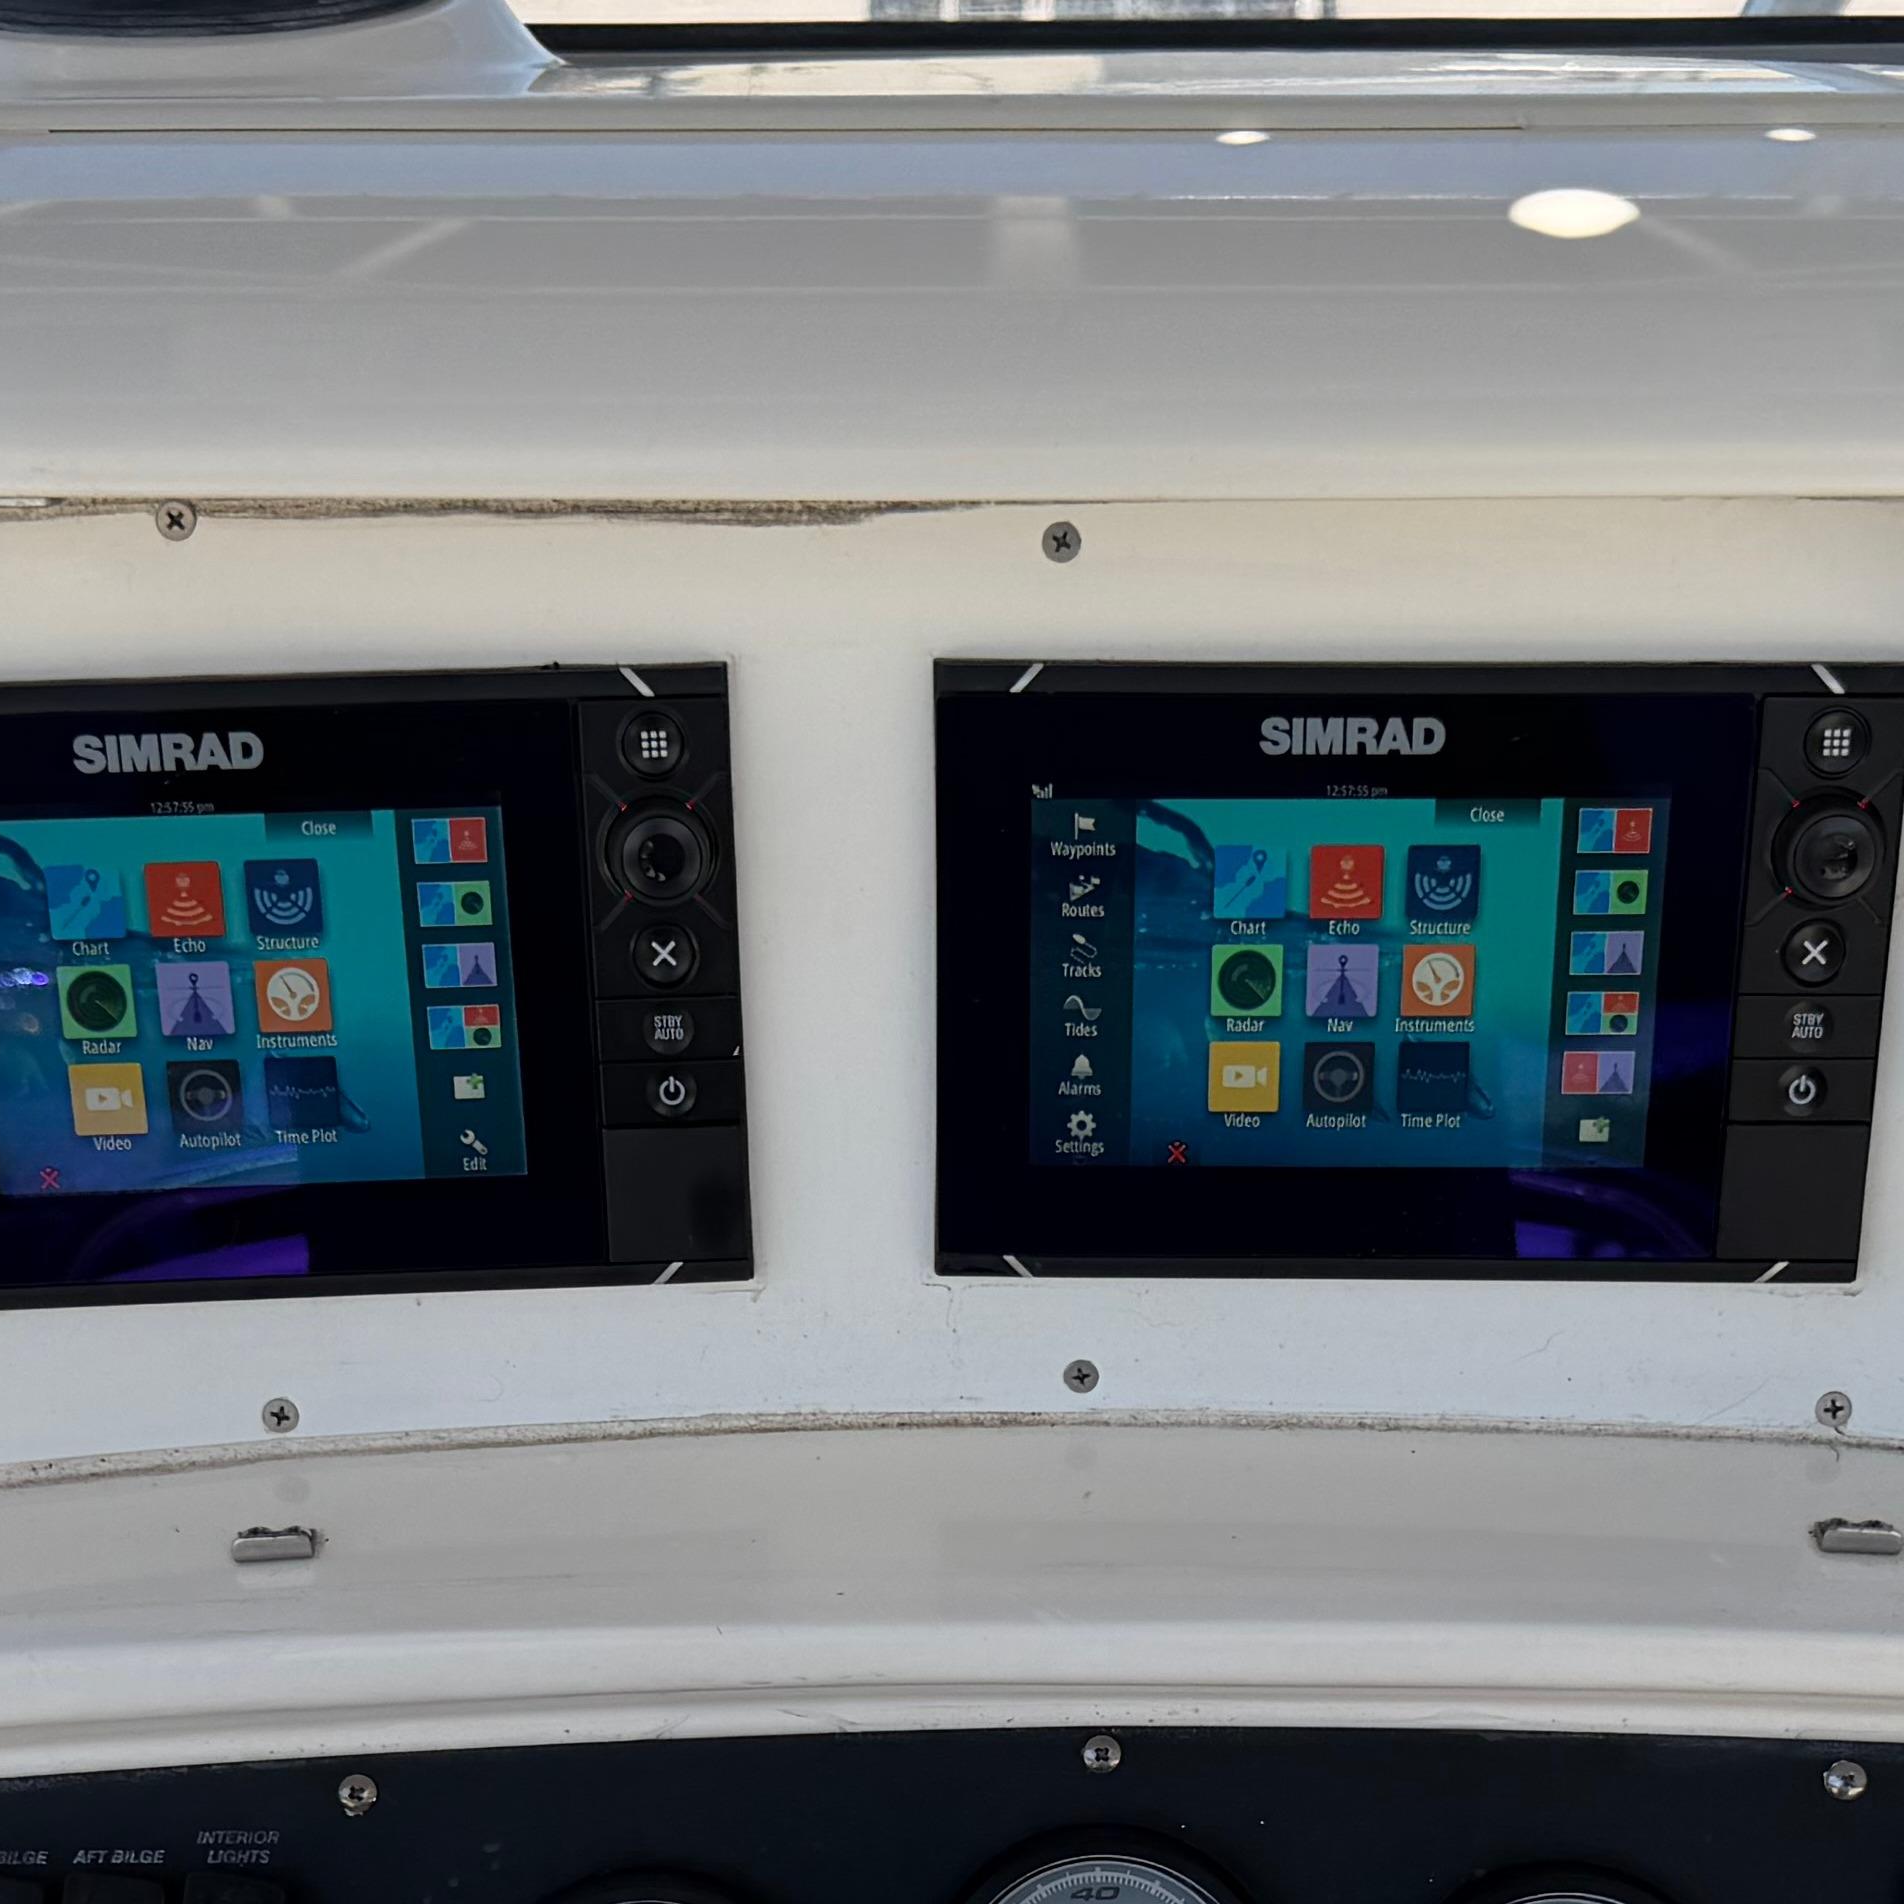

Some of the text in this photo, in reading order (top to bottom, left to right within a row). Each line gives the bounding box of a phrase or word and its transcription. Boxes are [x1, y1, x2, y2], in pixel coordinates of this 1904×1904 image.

[1259, 716, 1447, 756] SIMRAD
[73, 731, 265, 775] SIMRAD
[1326, 785, 1389, 798] 12:57:55 pm
[150, 802, 215, 814] 12:57:55 pm
[1470, 807, 1505, 823] Close
[302, 820, 337, 836] Close
[1050, 841, 1116, 859] Waypoints
[1062, 903, 1105, 918] Routes
[1230, 920, 1266, 936] Chart
[1328, 920, 1360, 936] Echo
[1410, 920, 1471, 936] Structure
[72, 940, 109, 957] Chart
[174, 937, 206, 953] Echo
[257, 934, 319, 951] Structure
[1062, 963, 1102, 979] Tracks
[654, 1014, 683, 1028] STBY
[1226, 1018, 1265, 1033] Radar
[1327, 1018, 1353, 1033] Nav
[1395, 1017, 1475, 1033] Instruments
[1793, 1012, 1824, 1026] STBY
[654, 1028, 684, 1040] AUTO
[1064, 1022, 1098, 1037] Tides
[1792, 1026, 1824, 1039] AUTO
[82, 1040, 122, 1056] Radar
[187, 1036, 213, 1051] Nav
[256, 1033, 338, 1049] Instruments
[1058, 1081, 1102, 1097] Alarms
[1224, 1113, 1261, 1128] Video
[1306, 1112, 1367, 1130] Autopilot
[1401, 1113, 1461, 1128] Time Plot
[93, 1136, 132, 1152] Video
[180, 1132, 241, 1150] Autopilot
[277, 1128, 338, 1144] Time Plot
[1055, 1138, 1105, 1157] Settings
[463, 1157, 487, 1172] Edit
[195, 1829, 281, 1847] INTERIOR
[72, 1848, 167, 1866] AFT BILGE
[206, 1848, 272, 1867] LIGHTS
[1071, 1886, 1121, 1901] 40
